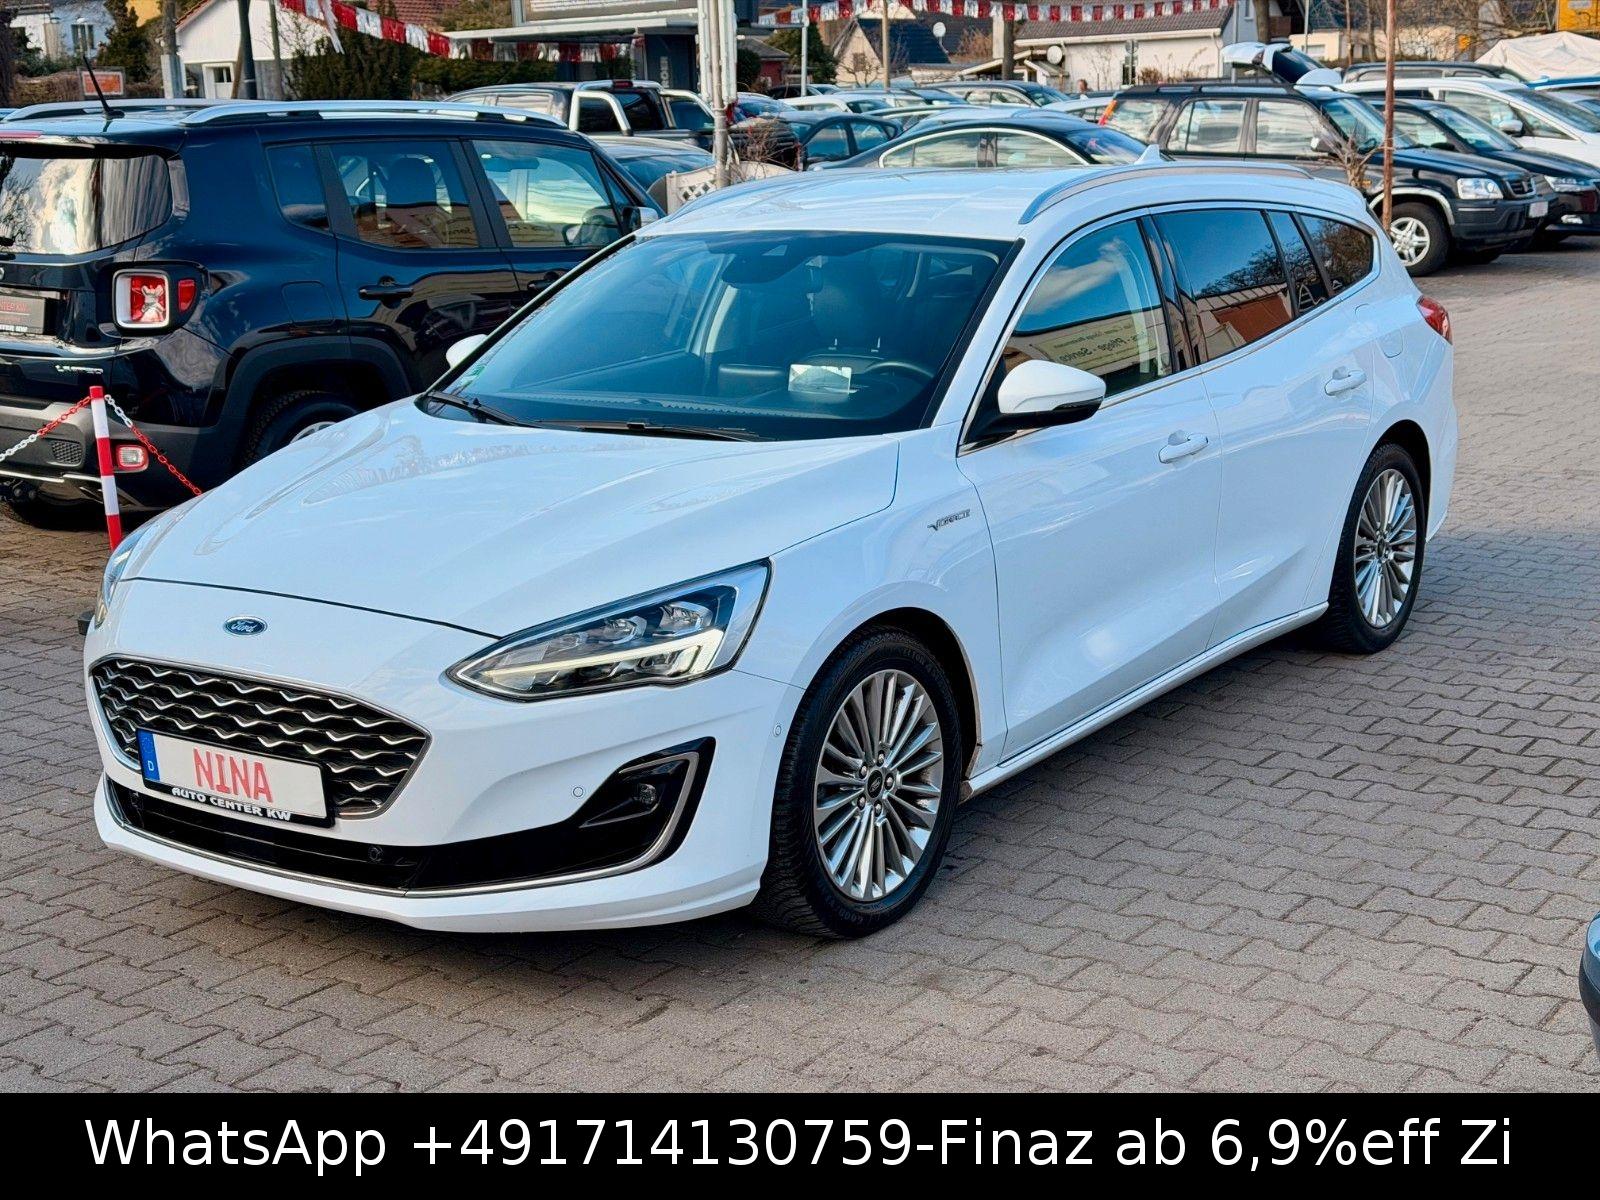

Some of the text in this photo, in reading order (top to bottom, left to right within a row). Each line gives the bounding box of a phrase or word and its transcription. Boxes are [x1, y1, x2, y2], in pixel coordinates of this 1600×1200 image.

[147, 760, 155, 772] D
[193, 746, 274, 804] NINA
[172, 787, 293, 822] AUTO CENTER KW
